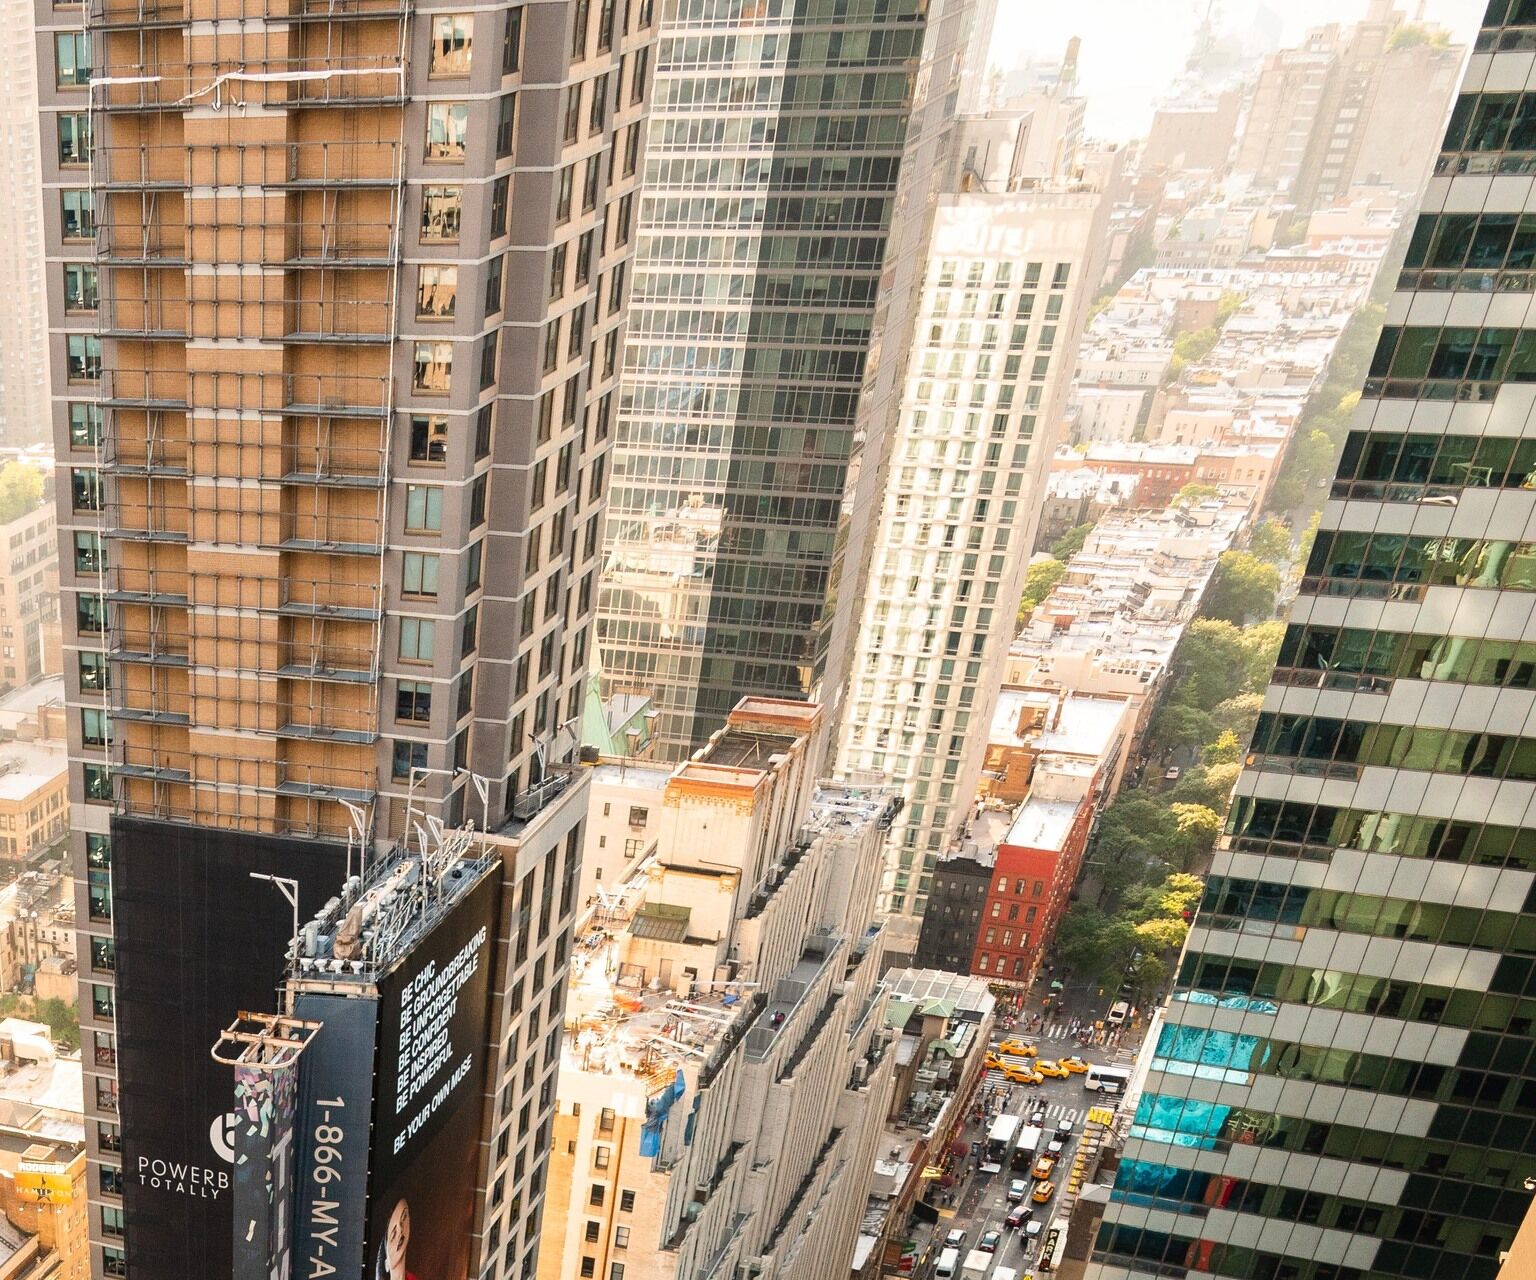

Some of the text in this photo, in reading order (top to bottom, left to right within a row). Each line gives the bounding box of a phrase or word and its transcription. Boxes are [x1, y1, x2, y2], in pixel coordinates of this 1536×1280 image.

[399, 953, 479, 1051] BE UNFORGETTABLE
[400, 925, 487, 1030] BE GROUNDBREAKING
[401, 960, 436, 1008] BE CHIC
[396, 1027, 449, 1093] BE INSPIRED
[398, 997, 458, 1073] BE CONFIDENT
[393, 1053, 473, 1156] BE YOUR OWN MUSE
[395, 1042, 453, 1115] BE POWERFUL
[138, 1156, 229, 1189] POWERB
[139, 1174, 220, 1200] TOTALLY
[1042, 1231, 1060, 1261] PARK
